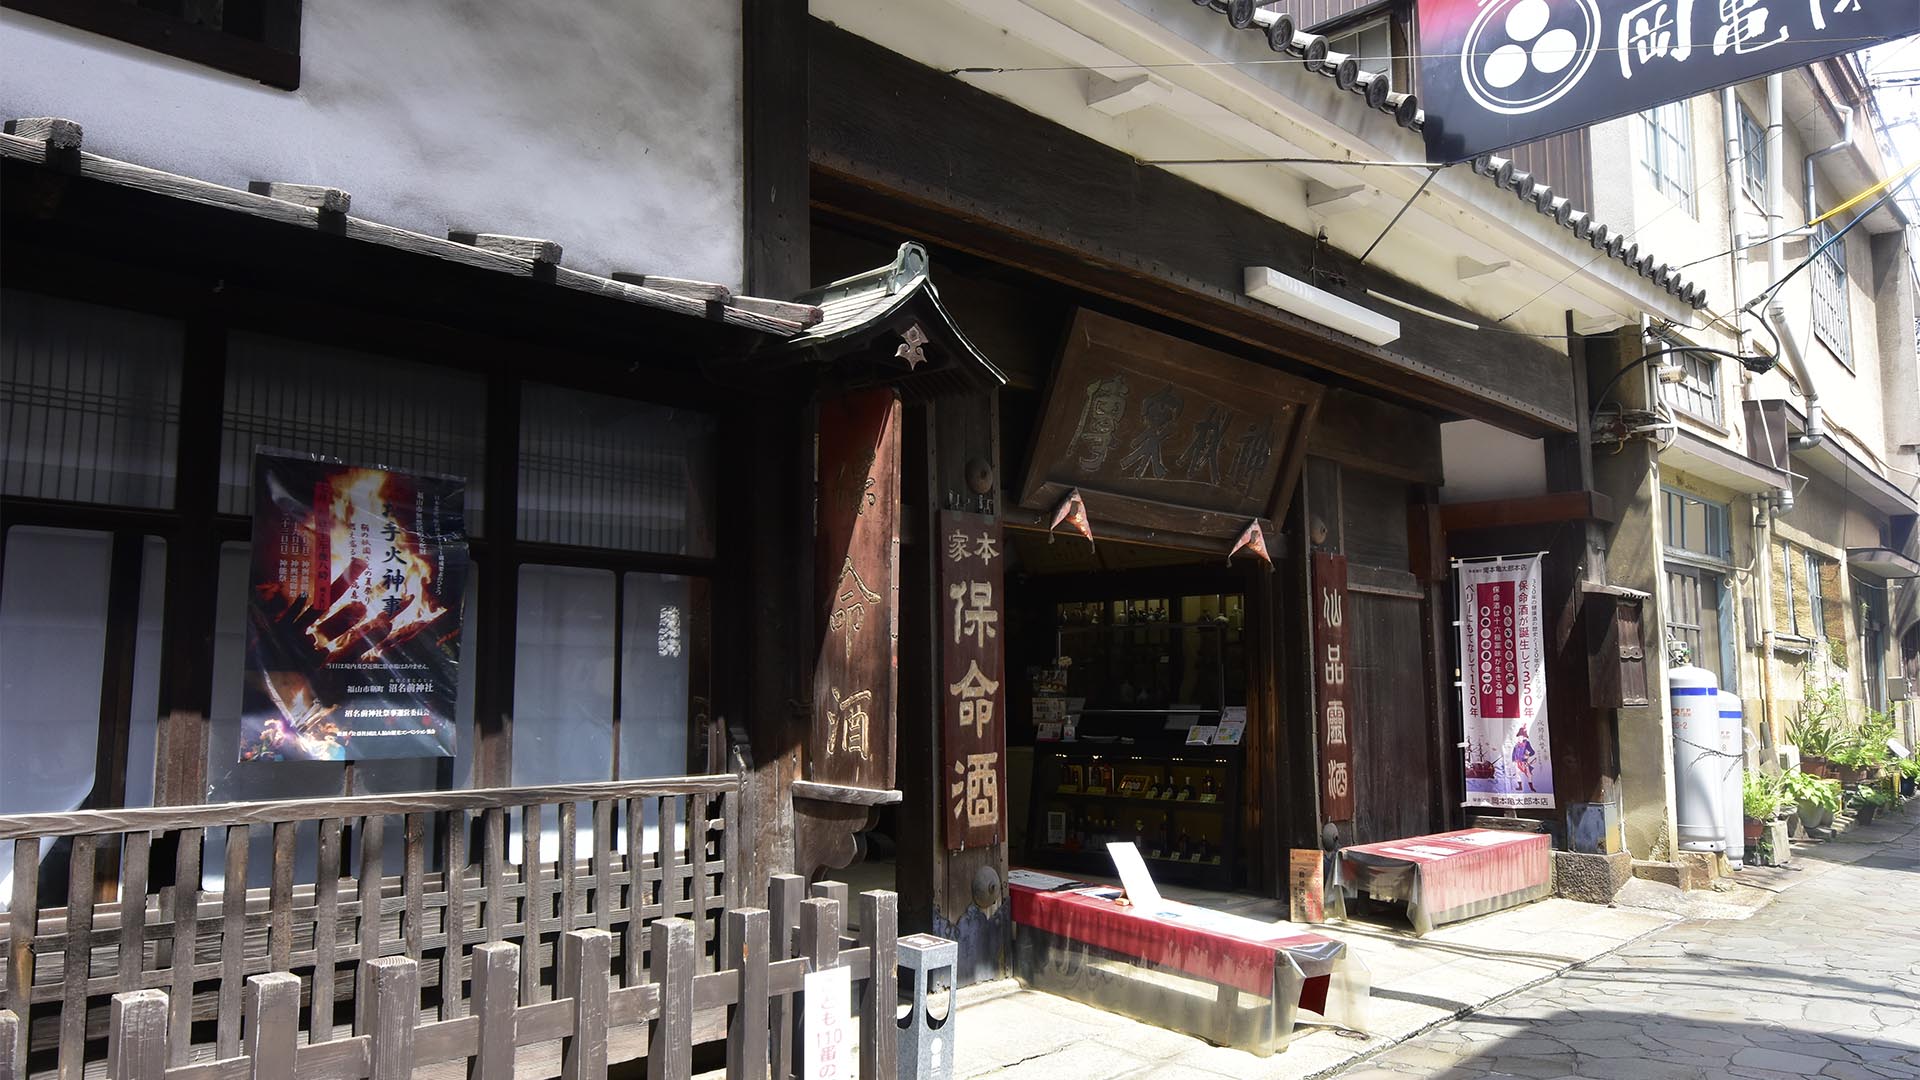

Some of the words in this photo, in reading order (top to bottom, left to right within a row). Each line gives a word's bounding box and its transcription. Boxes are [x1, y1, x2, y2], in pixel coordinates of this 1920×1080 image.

[947, 529, 1000, 566] 本家
[388, 683, 435, 693] 沼名前神社
[1517, 579, 1536, 718] 保命酒が誕生して350年
[948, 580, 1000, 828] 保命酒
